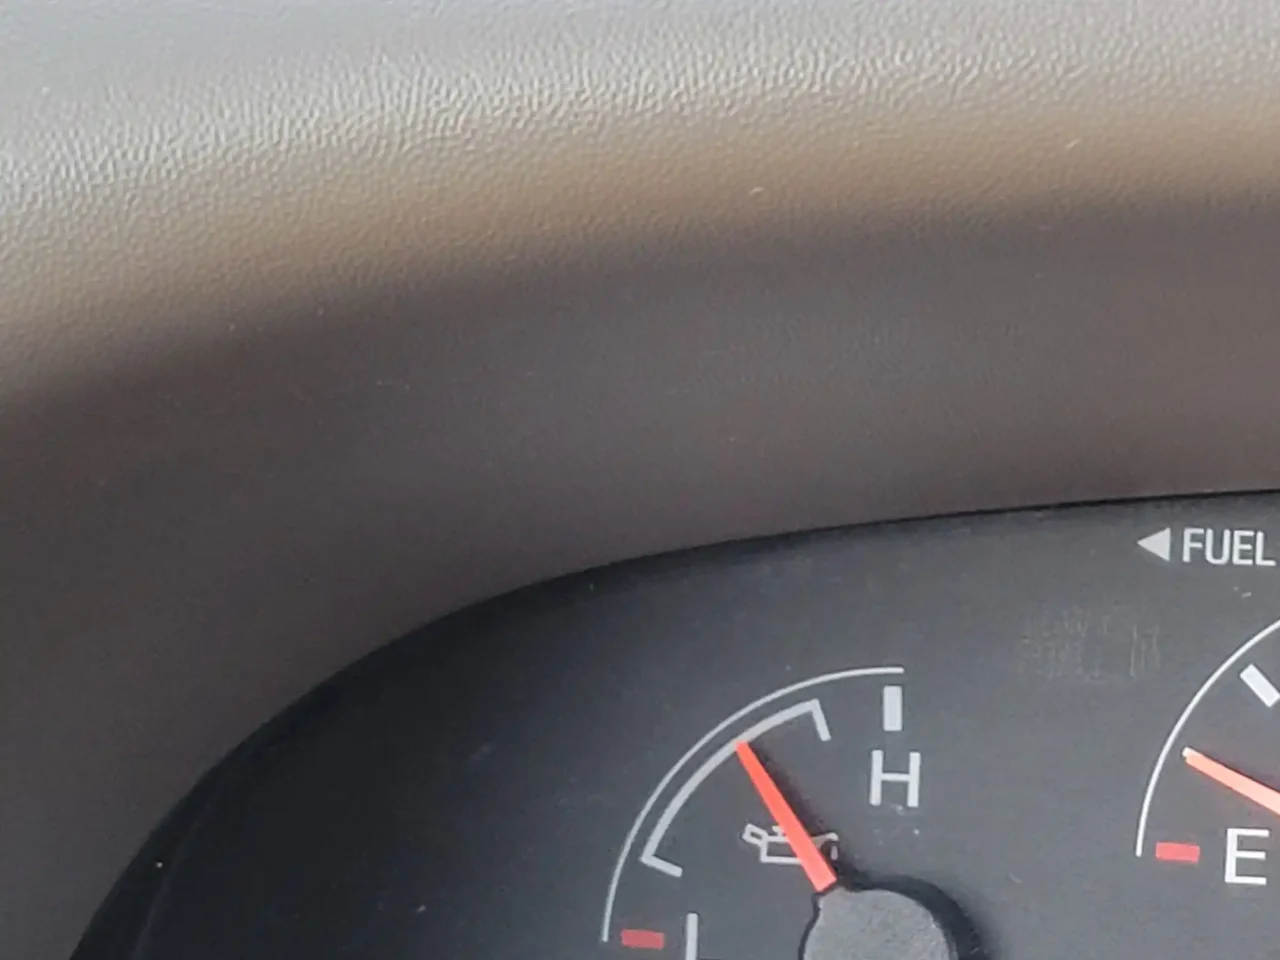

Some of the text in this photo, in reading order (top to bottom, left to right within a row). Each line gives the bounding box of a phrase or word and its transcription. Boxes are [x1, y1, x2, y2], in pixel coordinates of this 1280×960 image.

[1182, 528, 1276, 567] FUEL
[869, 749, 921, 808] H
[1224, 828, 1270, 885] E
